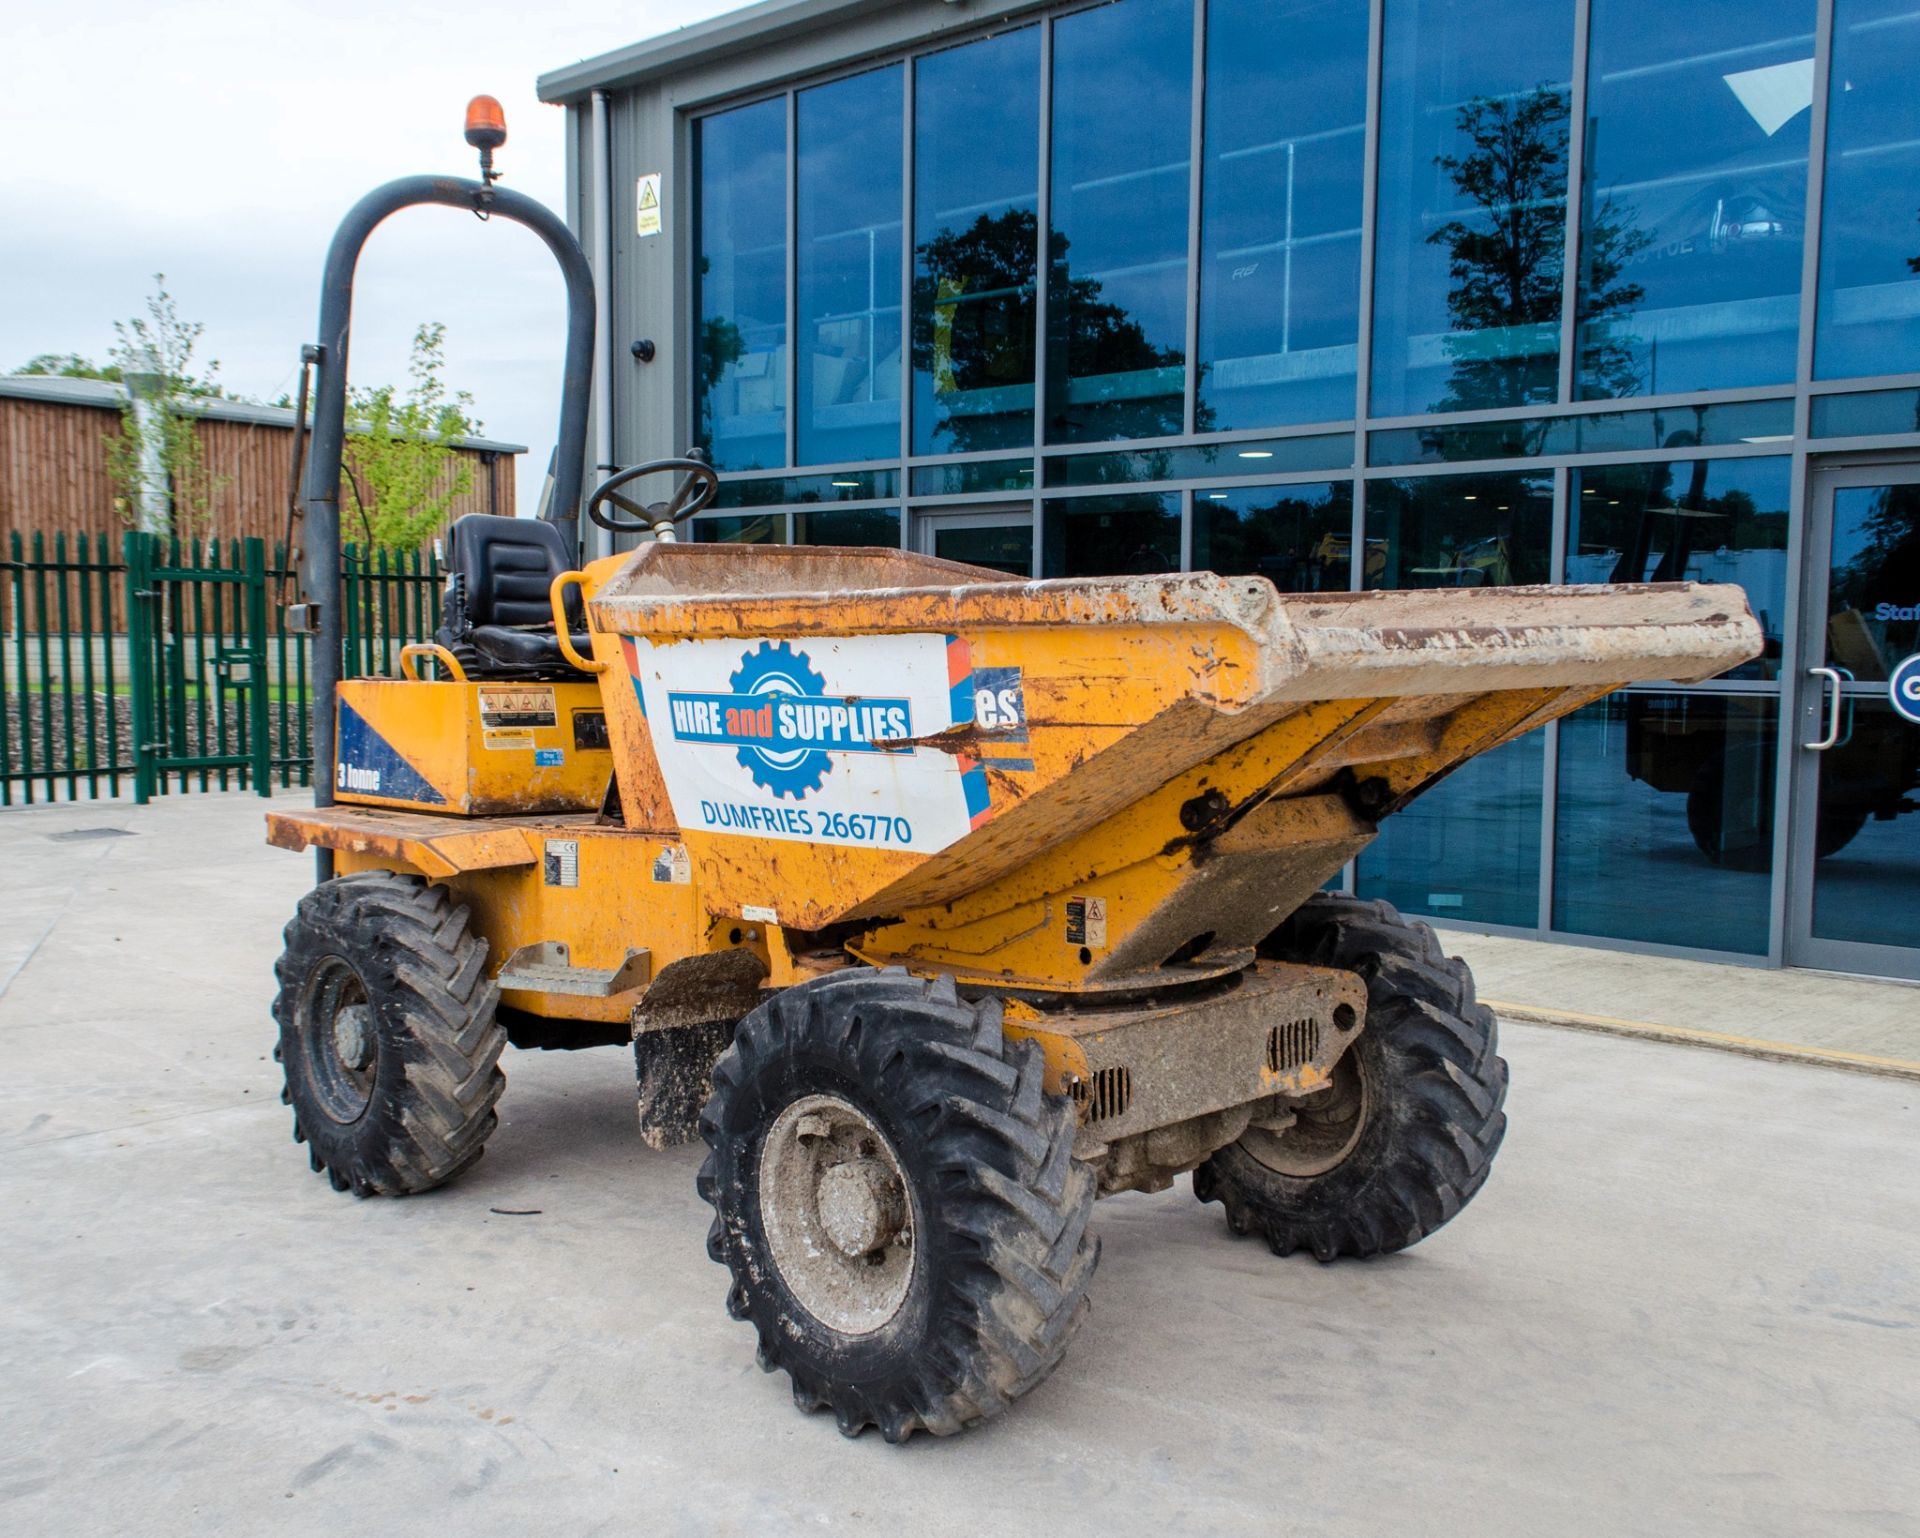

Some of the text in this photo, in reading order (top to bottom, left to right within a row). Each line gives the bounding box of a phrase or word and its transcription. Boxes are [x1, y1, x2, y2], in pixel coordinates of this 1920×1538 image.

[672, 700, 907, 742] HIRE and SUPPLIES
[975, 689, 1019, 730] es
[337, 763, 346, 788] 3
[701, 800, 912, 844] DUMFRIES 266770
